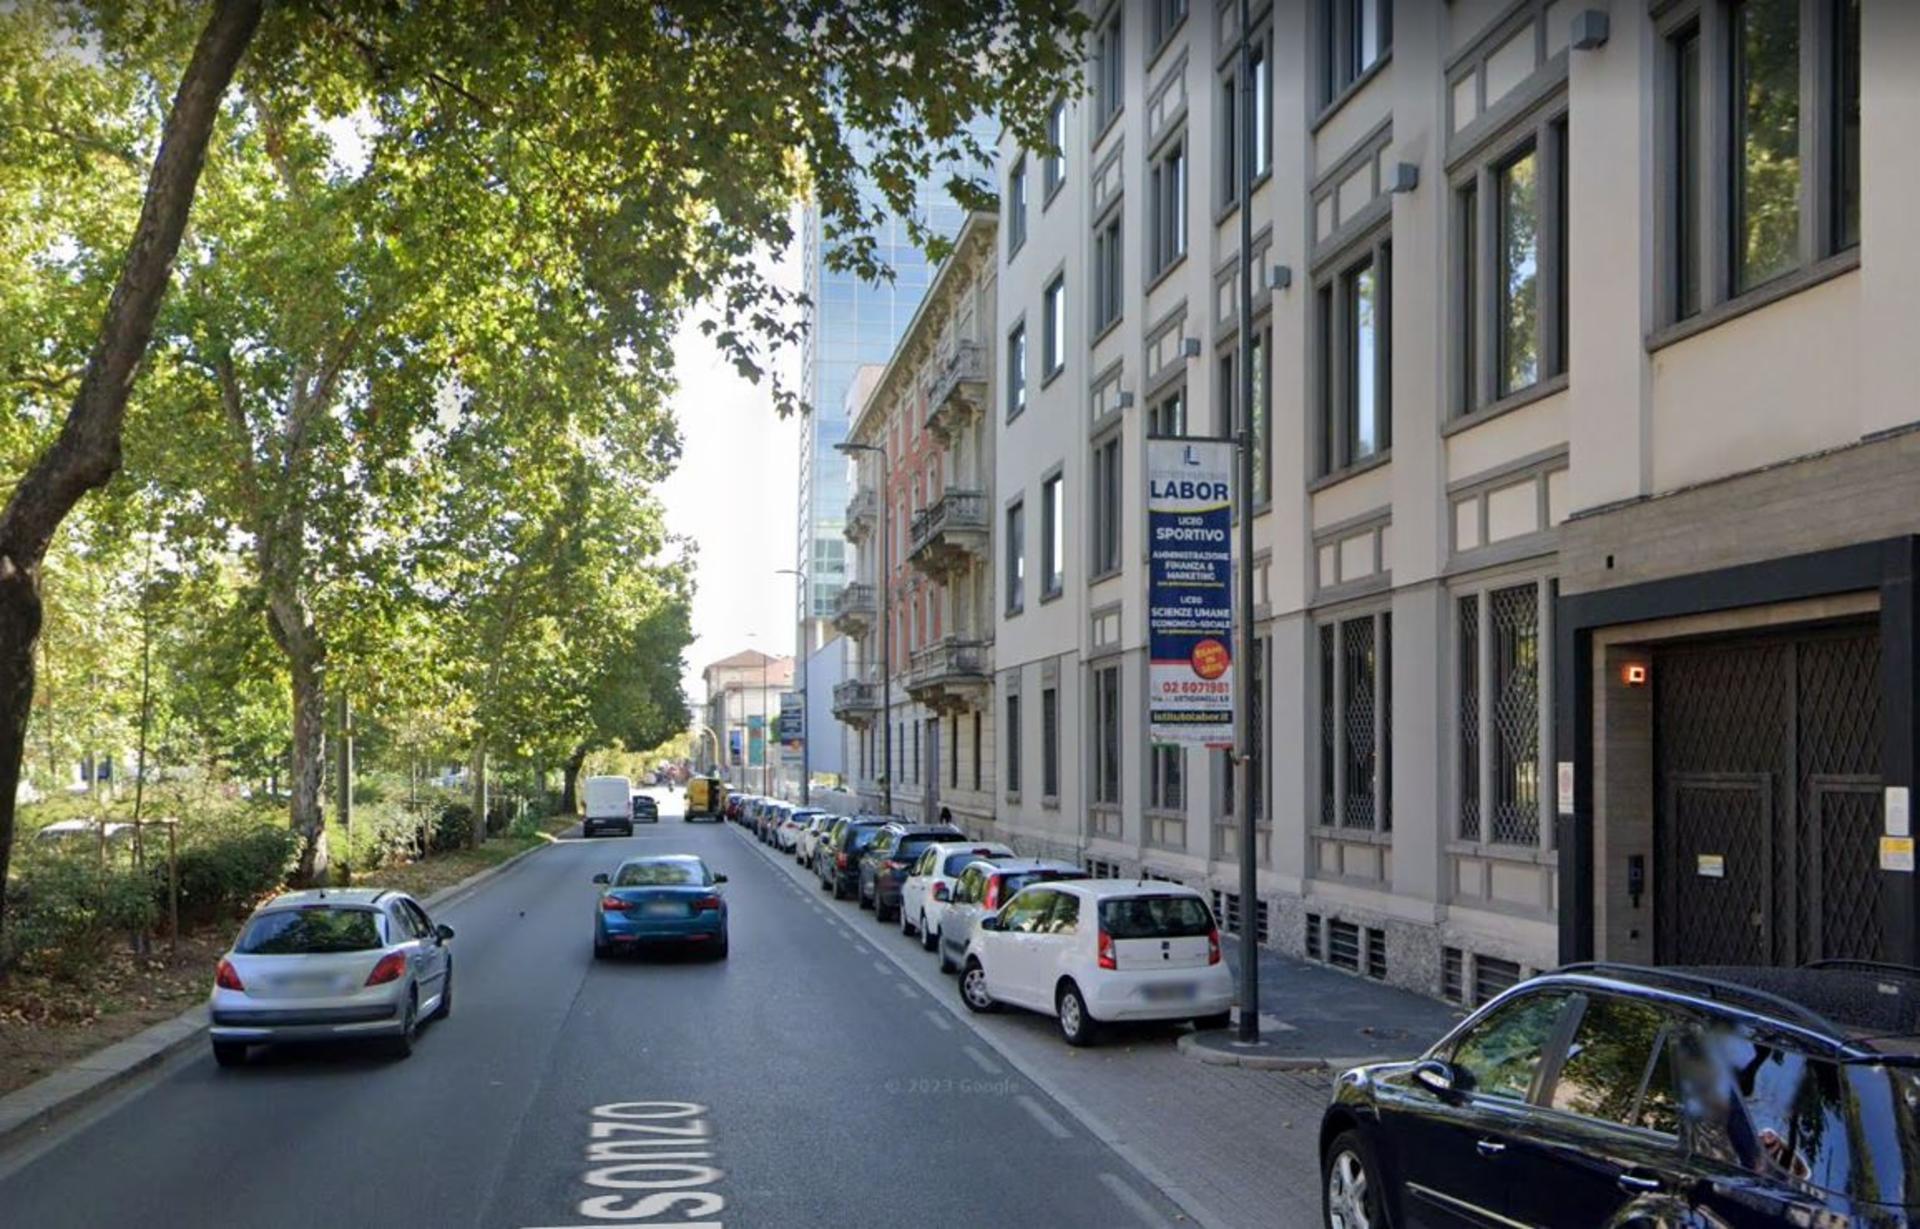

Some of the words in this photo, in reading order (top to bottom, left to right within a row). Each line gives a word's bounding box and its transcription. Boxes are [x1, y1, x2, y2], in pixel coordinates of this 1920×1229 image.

[1150, 480, 1228, 500] LABOR
[1178, 517, 1203, 526] LICEO
[1156, 528, 1224, 542] SPORTIVO
[1153, 551, 1229, 560] AMMINISTRAZIONE
[1165, 562, 1205, 570] FINANZA
[1167, 572, 1215, 580] MARKETING
[1180, 596, 1202, 604] LICEO
[1152, 608, 1192, 617] SCIENZE
[1194, 608, 1230, 618] UMANE
[1151, 619, 1231, 629] ECONOMICO-SOCIALE
[1163, 682, 1178, 693] 02
